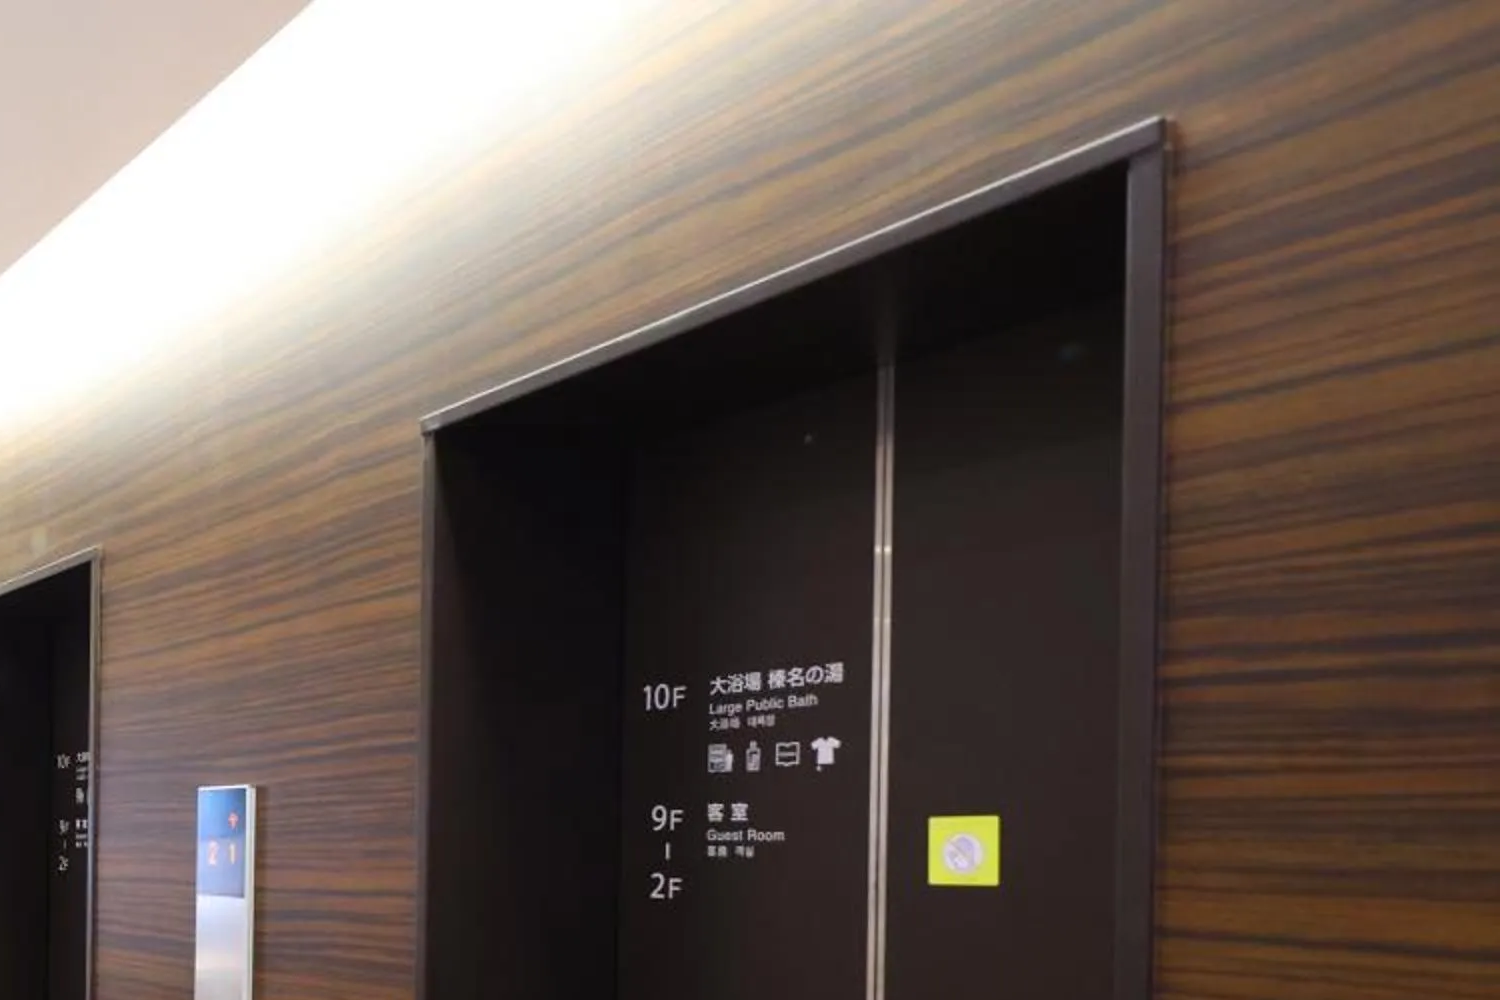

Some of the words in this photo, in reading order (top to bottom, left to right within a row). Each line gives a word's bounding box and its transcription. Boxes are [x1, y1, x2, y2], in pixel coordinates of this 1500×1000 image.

[643, 683, 687, 711] 10F
[708, 703, 743, 716] Large
[745, 698, 785, 712] Public
[787, 693, 819, 708] Bath
[651, 805, 684, 831] 9F
[707, 828, 743, 841] Guest
[747, 829, 785, 842] Room
[650, 872, 683, 899] 2F
